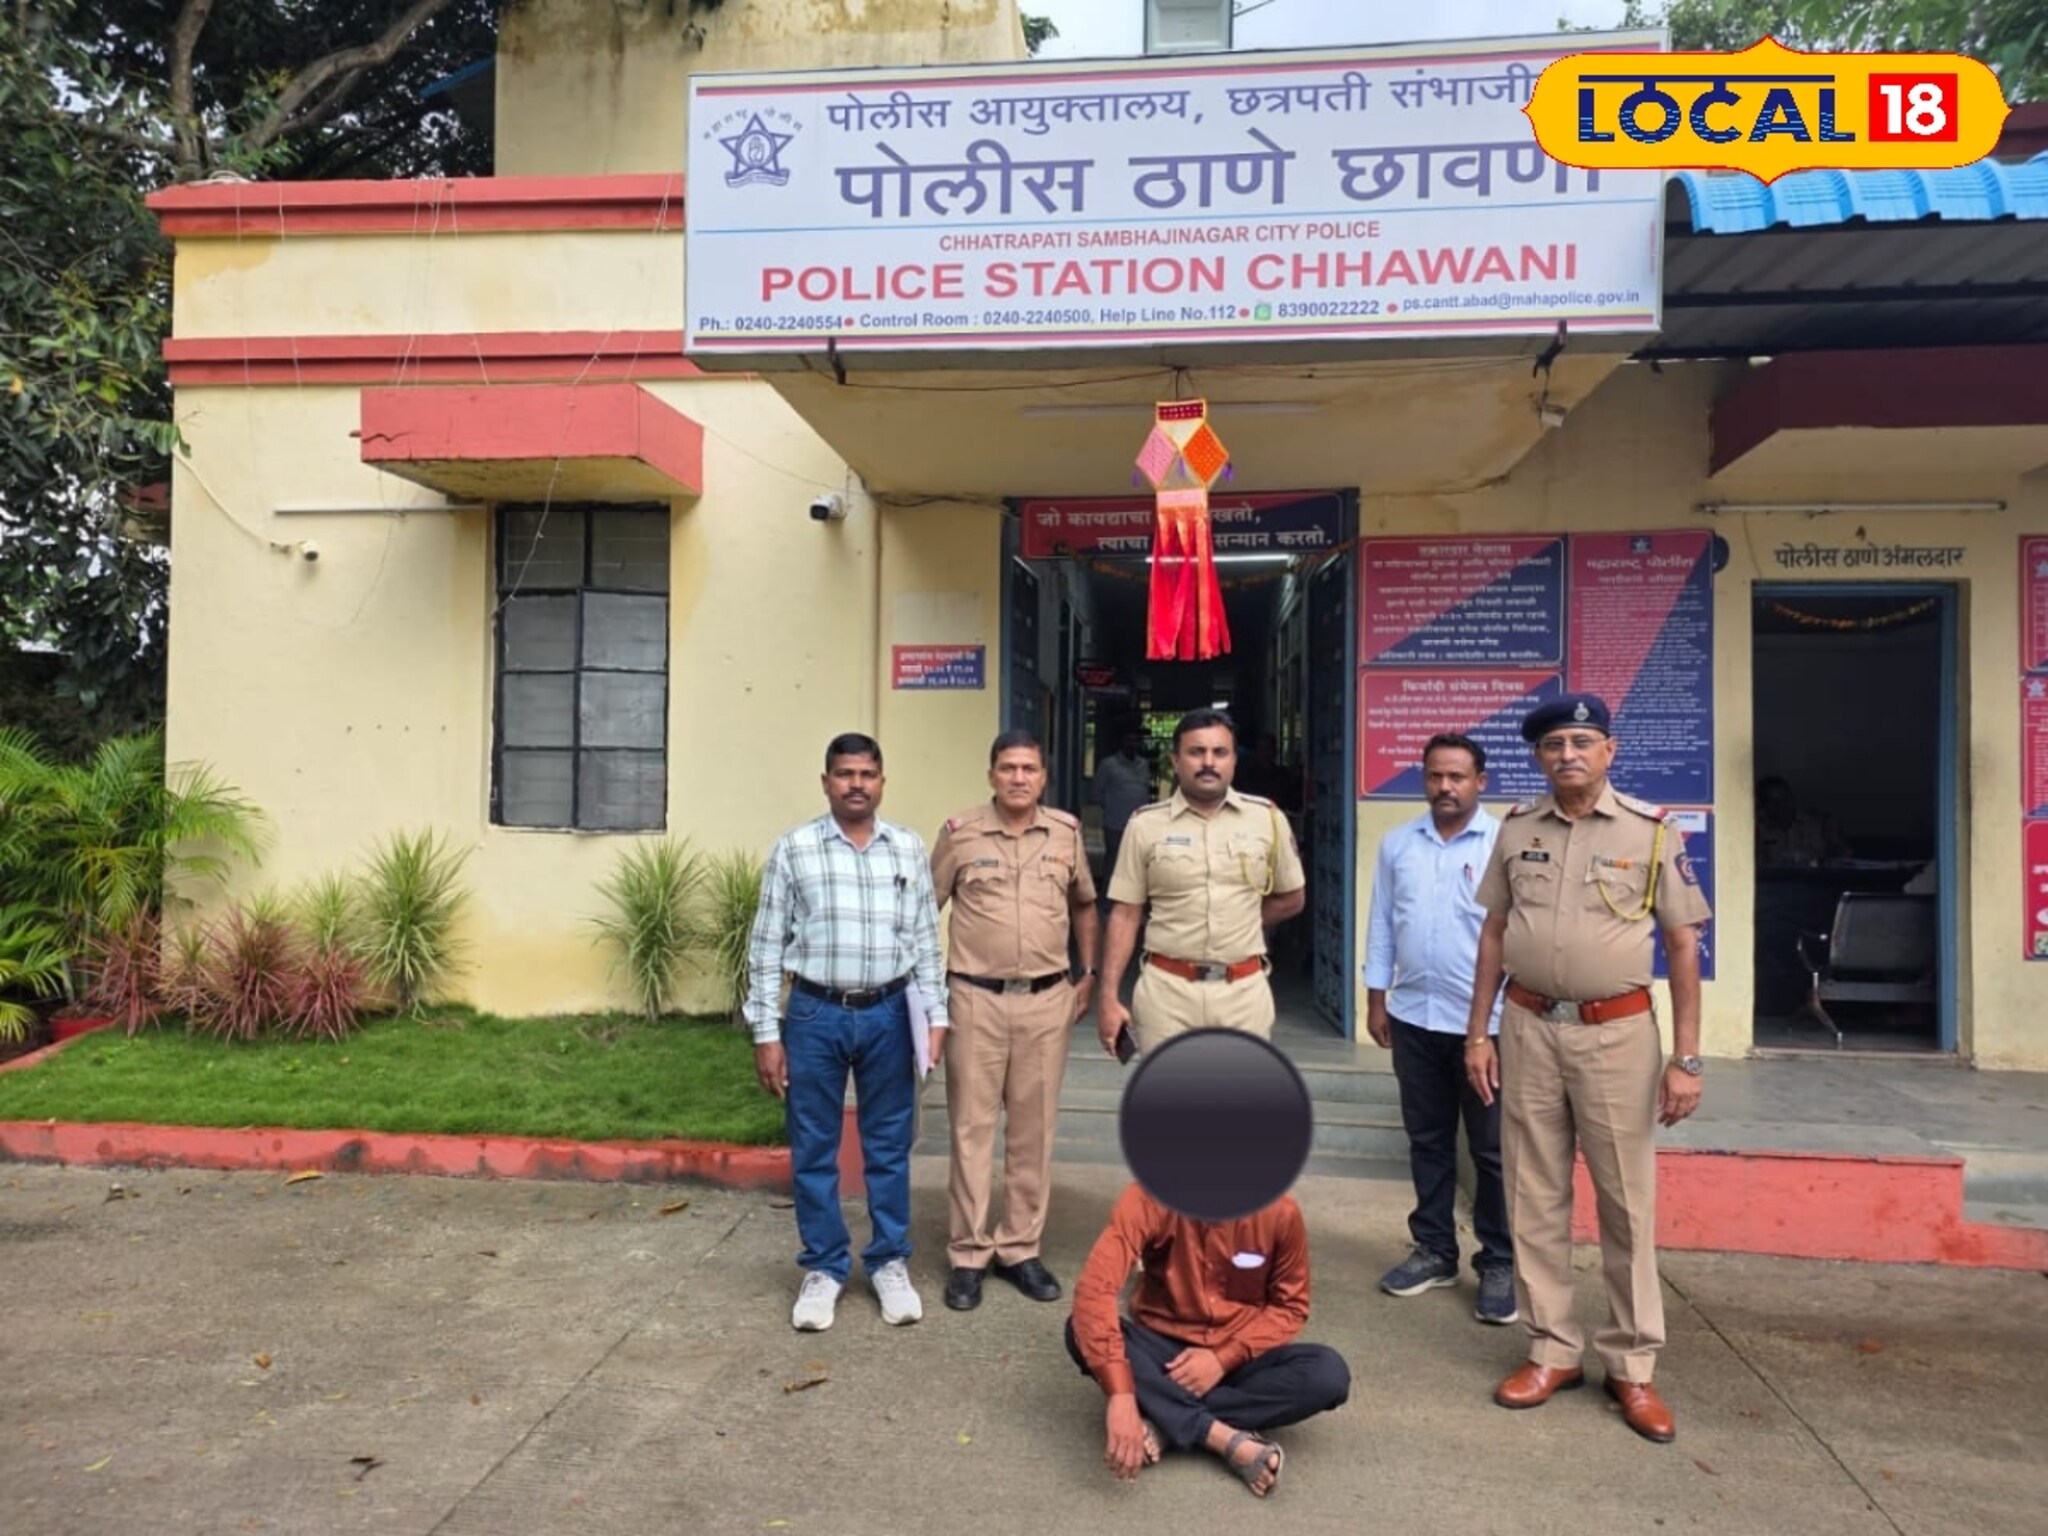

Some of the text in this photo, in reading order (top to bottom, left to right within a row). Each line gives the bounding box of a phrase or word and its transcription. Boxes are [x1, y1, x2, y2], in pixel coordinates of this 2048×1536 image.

[827, 91, 952, 132] पोलीस
[969, 88, 1204, 134] आयुक्तालय,
[1227, 70, 1371, 118] छत्रपती
[834, 139, 1095, 218] पोलीस
[1128, 128, 1296, 210] ठाणे
[940, 220, 1380, 252] CHHATRAPATI SAMBHAJINAGAR CITY POLICE
[762, 243, 1577, 303] POLICE STATION CHHAWANI
[734, 315, 843, 331] 0240-2240554
[860, 312, 918, 328] Control
[922, 311, 968, 327] Room
[1100, 308, 1136, 323] Help
[1141, 307, 1175, 322] Line
[1180, 304, 1237, 320] No.112
[1278, 300, 1380, 318] 8390022222
[1403, 289, 1640, 312] ps.cantt.abad@mahapolice.gov.in
[1036, 507, 1061, 527] जो
[1214, 531, 1270, 548] सन्मान
[1775, 542, 1966, 569] पोलीस ठाणे अंमलदार
